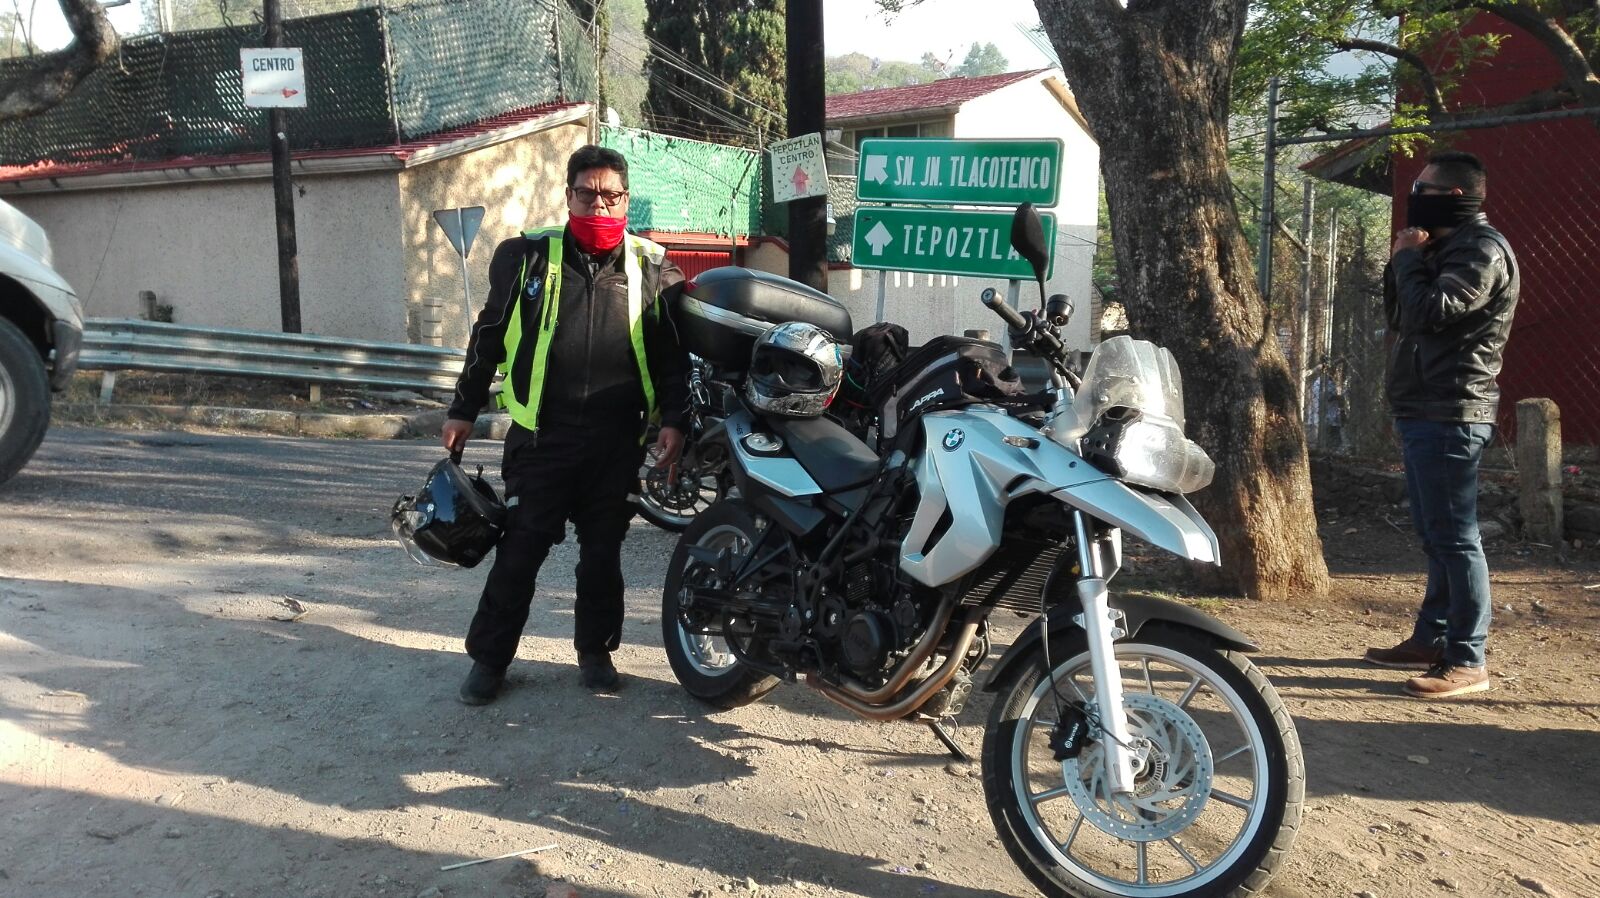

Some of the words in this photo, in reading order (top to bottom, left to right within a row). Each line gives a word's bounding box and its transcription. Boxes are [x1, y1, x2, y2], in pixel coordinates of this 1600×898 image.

[252, 57, 295, 72] CENTRO
[780, 150, 815, 165] CENTRO
[894, 155, 916, 187] SN.
[920, 156, 943, 187] JN.
[949, 155, 1051, 190] TLACOTENCO
[903, 224, 1028, 262] TEPOZTLA
